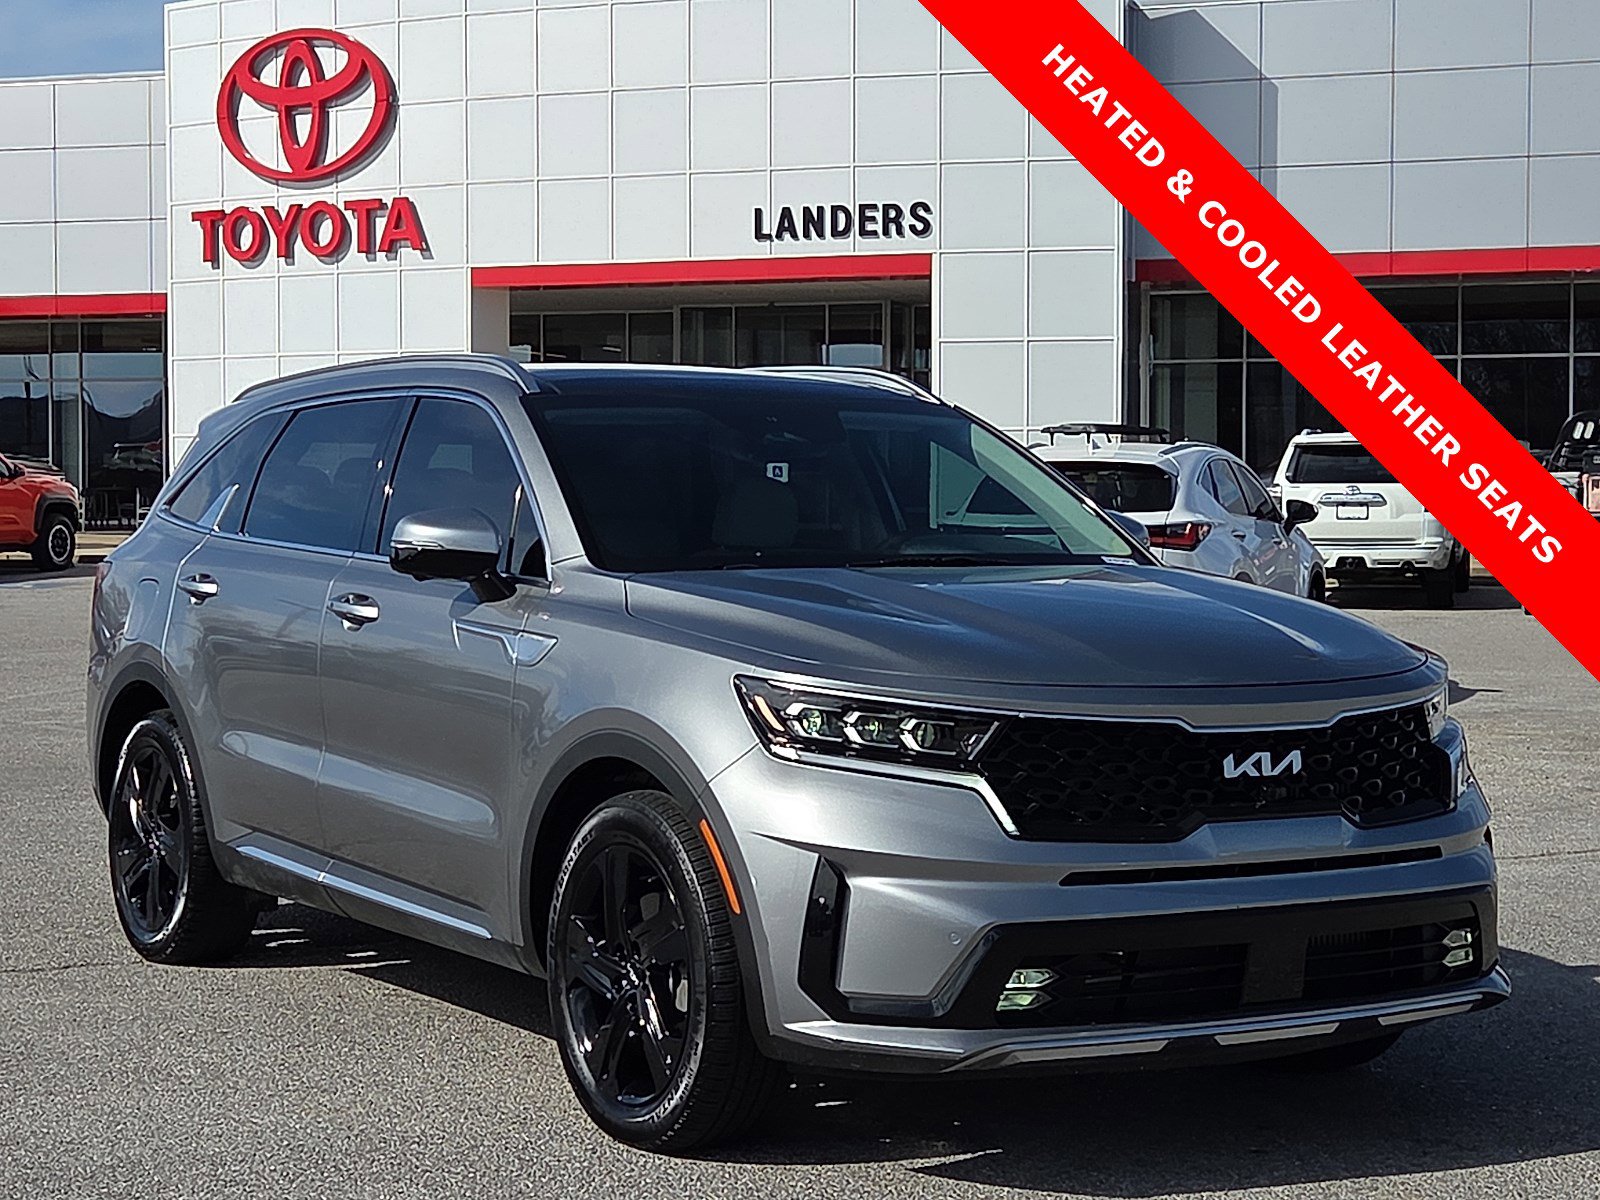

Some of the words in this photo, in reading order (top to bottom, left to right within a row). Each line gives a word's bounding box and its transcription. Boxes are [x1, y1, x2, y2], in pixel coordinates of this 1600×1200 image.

[192, 198, 425, 263] TOYOTA
[755, 202, 934, 242] LANDERS
[1223, 750, 1302, 778] KIA
